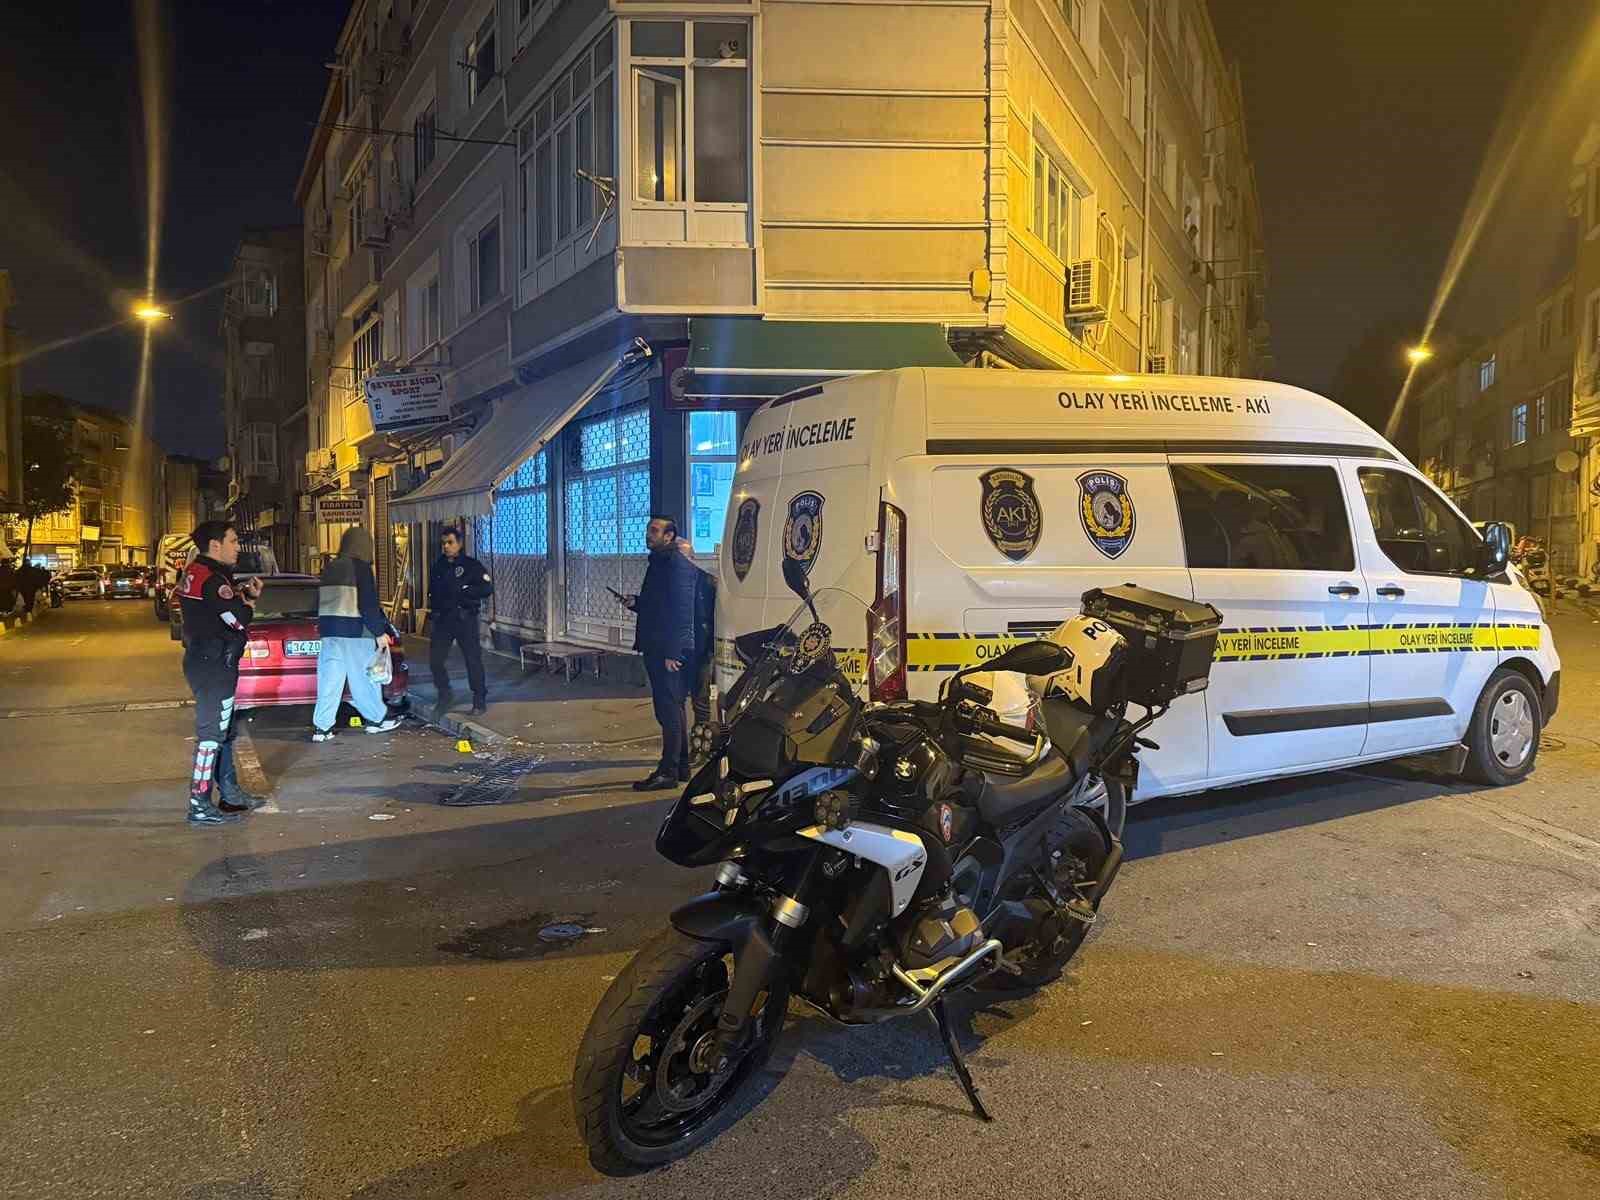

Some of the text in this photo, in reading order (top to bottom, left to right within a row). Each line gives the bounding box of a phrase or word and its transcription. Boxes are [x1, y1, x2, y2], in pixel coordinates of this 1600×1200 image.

[1058, 391, 1104, 409] OLAY
[1108, 391, 1149, 410] YERİ
[1151, 391, 1234, 413] İNCELEME
[1245, 395, 1271, 414] AKİ
[763, 425, 785, 456] YERİ
[786, 417, 857, 450] İNCELEME
[1231, 635, 1251, 651] YERİ
[1254, 635, 1300, 650] İNCELEME
[1400, 630, 1474, 646] OLAY YERİ İNCELEME
